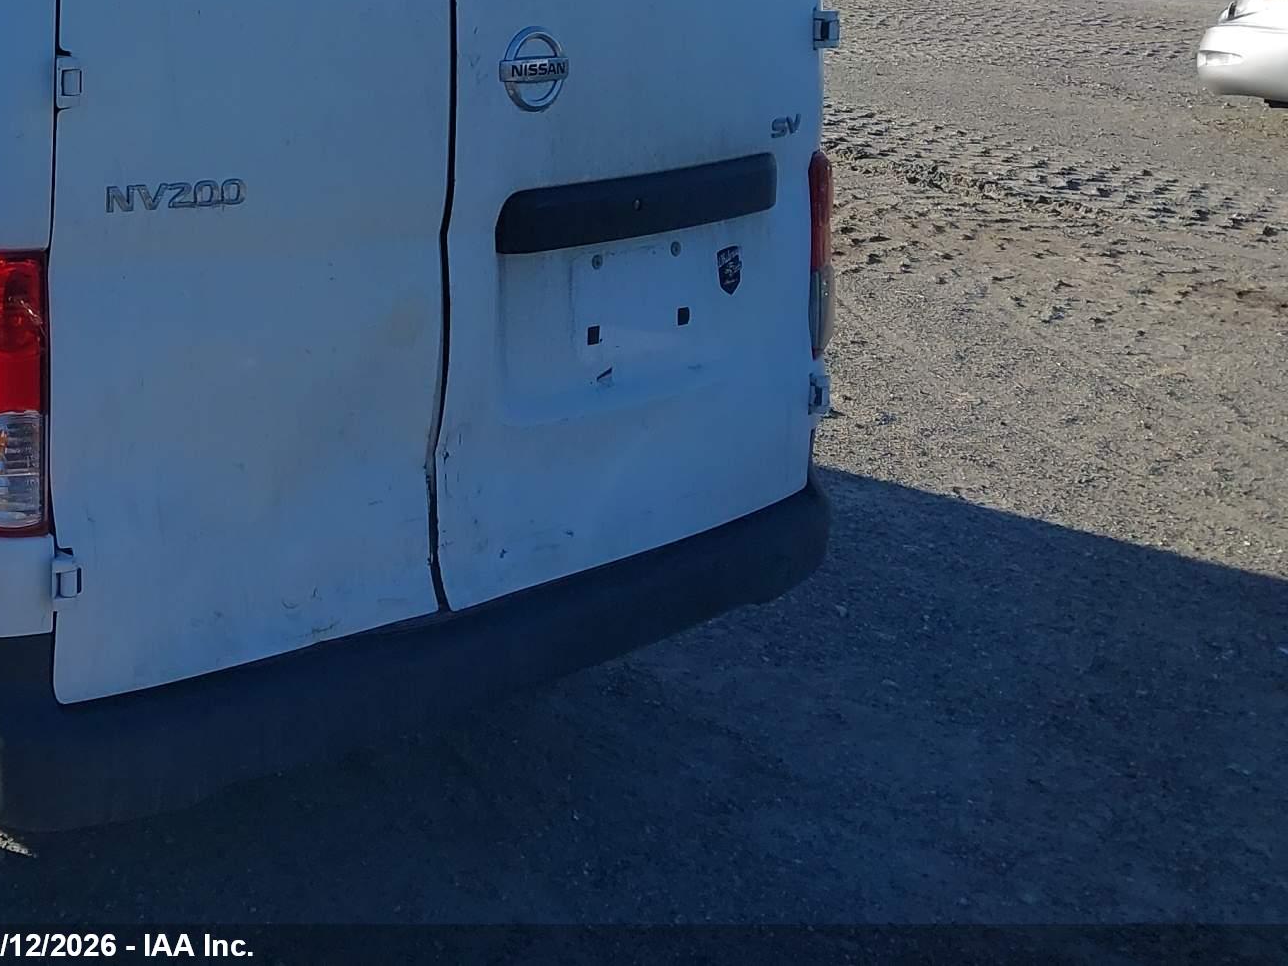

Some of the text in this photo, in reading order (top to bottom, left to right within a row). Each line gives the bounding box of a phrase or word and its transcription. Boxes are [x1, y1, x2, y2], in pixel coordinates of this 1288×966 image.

[511, 62, 566, 77] NISSAN
[771, 113, 801, 138] SV
[105, 178, 246, 213] NV200
